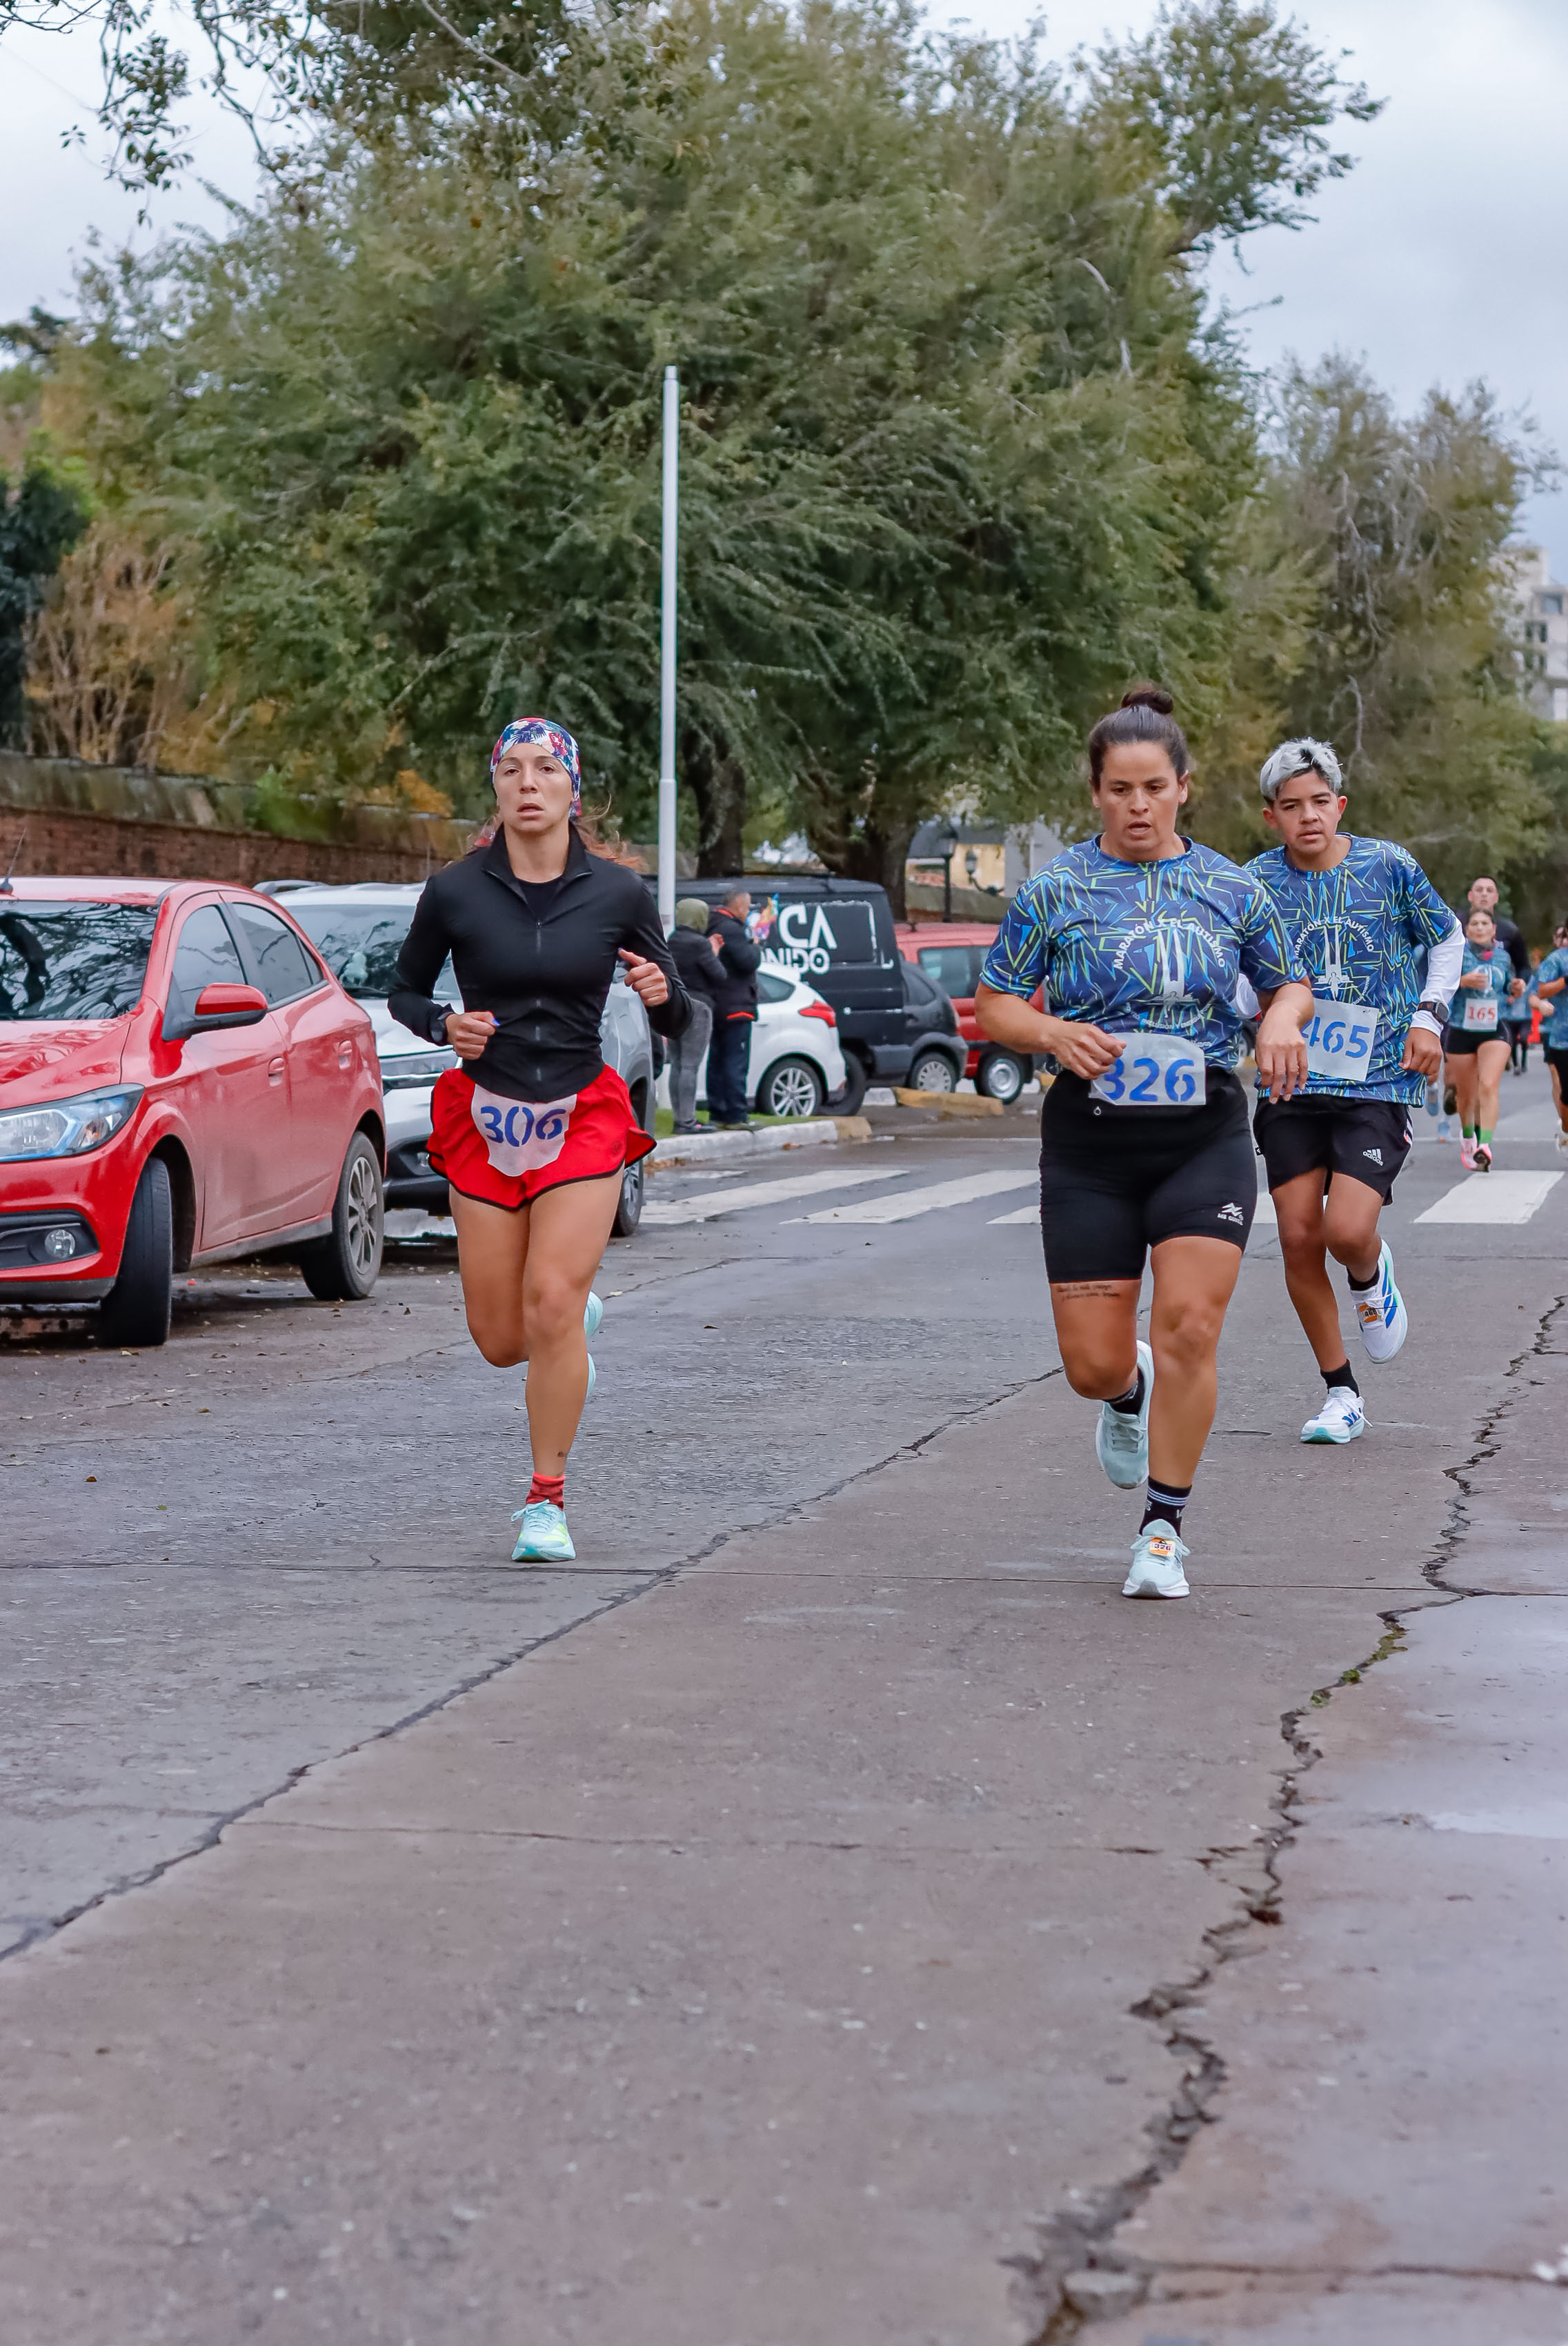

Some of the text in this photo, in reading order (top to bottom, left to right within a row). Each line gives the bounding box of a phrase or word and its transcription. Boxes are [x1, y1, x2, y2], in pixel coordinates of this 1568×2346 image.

[1113, 917, 1226, 970] MARATÓN X EL AUTISMO
[1324, 916, 1331, 924] X
[1333, 916, 1343, 924] EL
[1345, 918, 1375, 952] AUTISMO
[1468, 1006, 1496, 1021] 165
[1300, 1016, 1370, 1058] 465
[1104, 1057, 1197, 1102] 326
[481, 1106, 566, 1147] 306
[1362, 1151, 1384, 1166] adidas
[1154, 1543, 1171, 1551] 326
